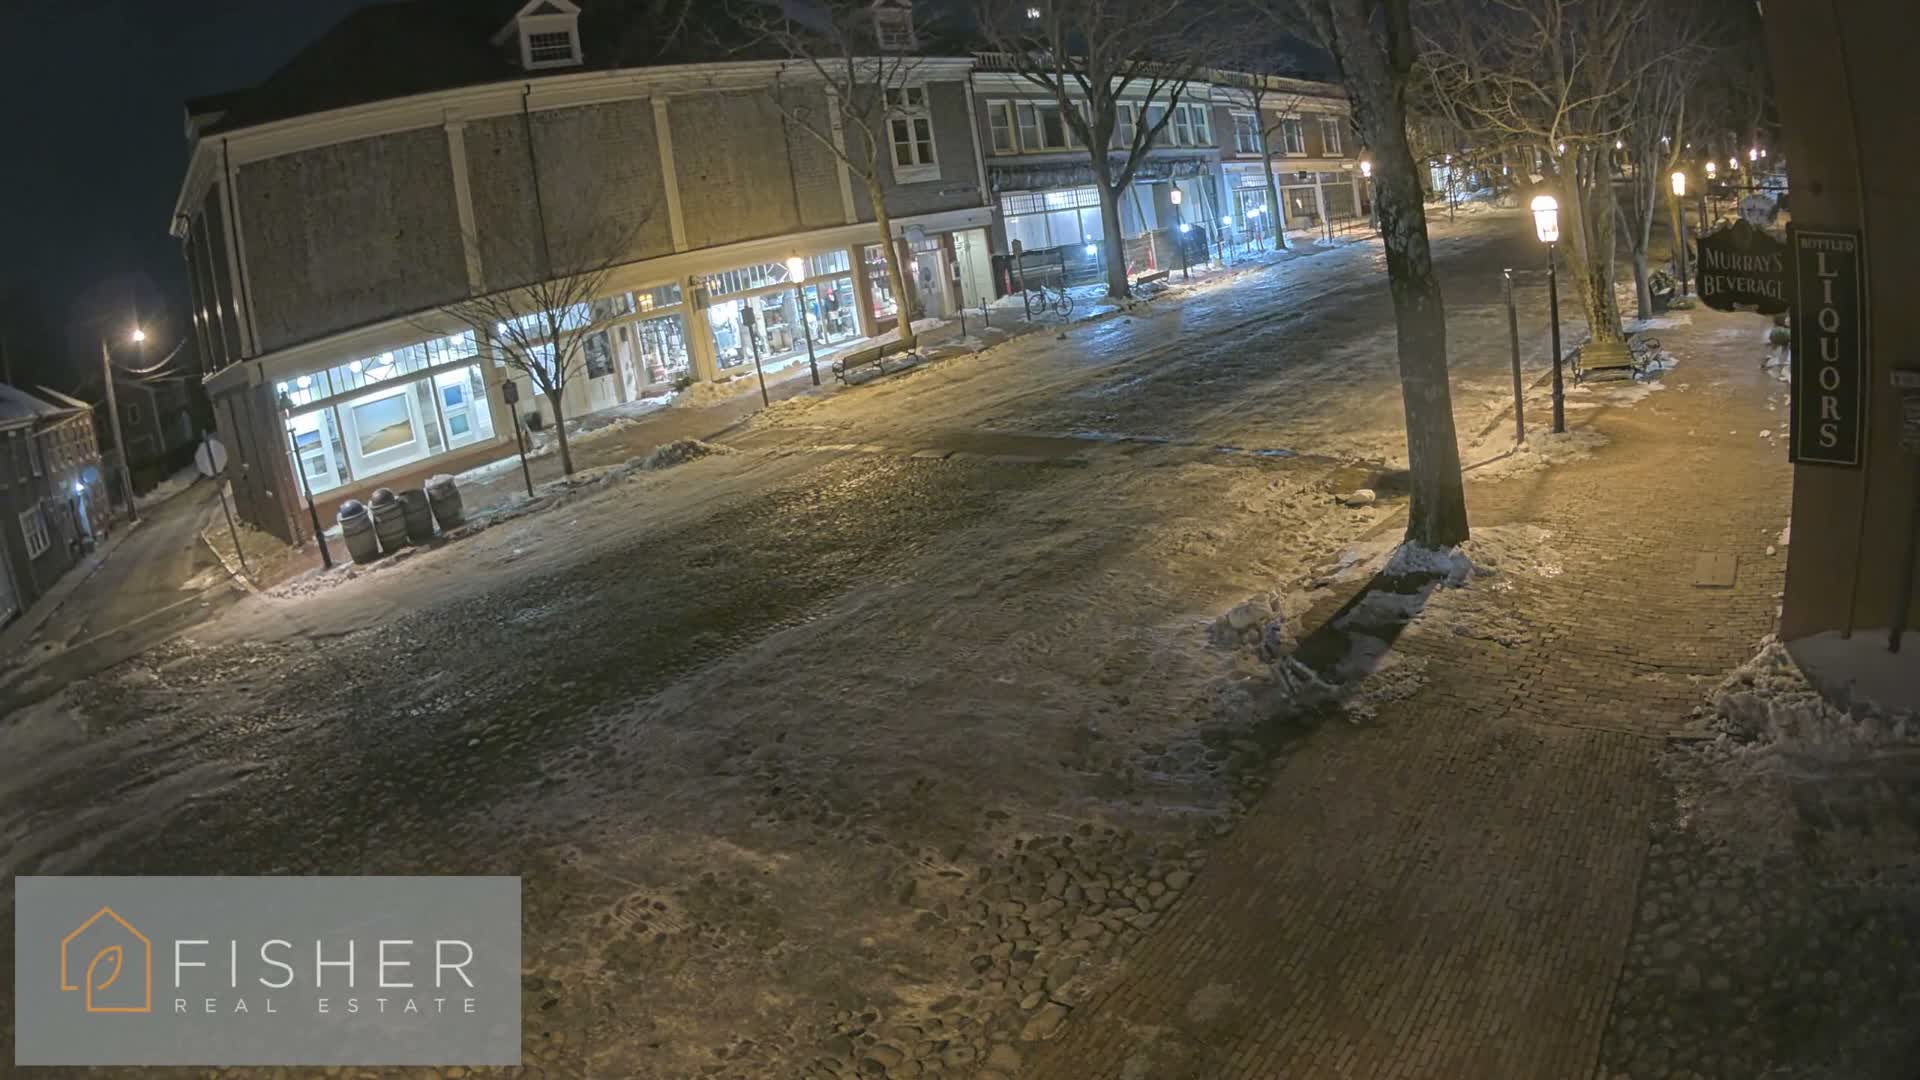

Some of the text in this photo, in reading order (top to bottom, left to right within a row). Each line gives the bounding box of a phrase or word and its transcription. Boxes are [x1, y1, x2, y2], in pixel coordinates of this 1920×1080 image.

[1800, 238, 1854, 251] BOTTLED
[1704, 247, 1783, 273] MURRAY'S
[1816, 251, 1841, 448] LIQUORS
